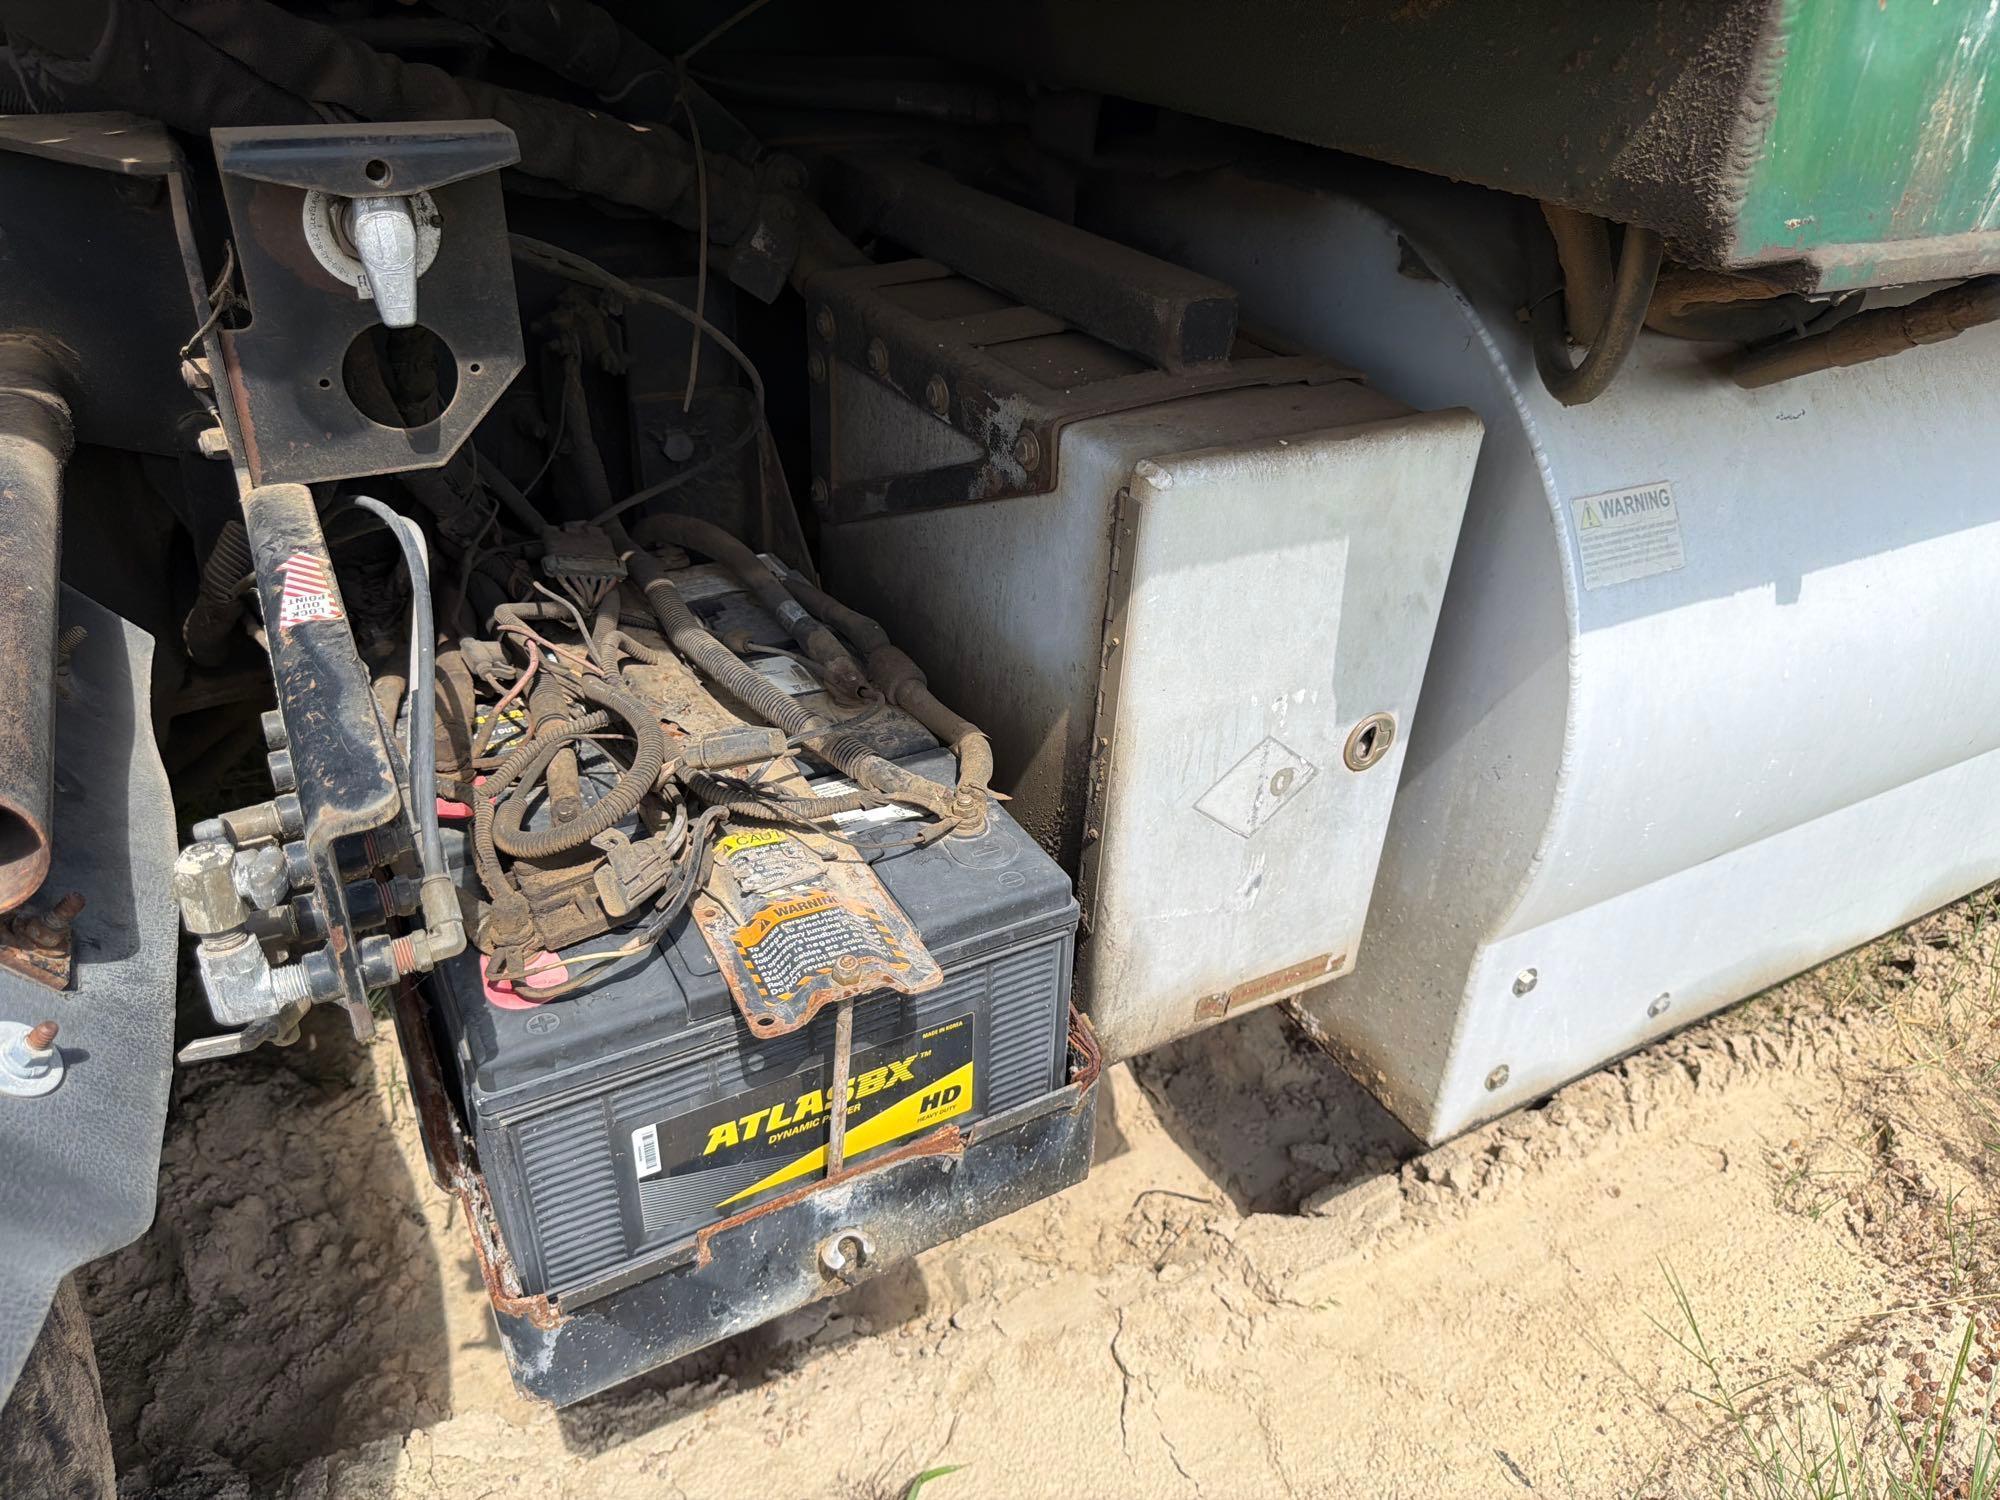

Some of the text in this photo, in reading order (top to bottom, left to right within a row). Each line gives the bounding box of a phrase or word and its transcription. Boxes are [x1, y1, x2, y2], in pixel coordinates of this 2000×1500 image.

[1598, 488, 1671, 520] WARNING
[288, 594, 325, 605] POINT
[291, 608, 325, 618] LOCK
[295, 601, 320, 610] OUT
[751, 933, 784, 959] damage
[786, 926, 796, 934] to
[754, 948, 778, 966] follow
[778, 931, 806, 949] battery
[807, 920, 842, 937] jumping
[761, 927, 780, 947] avoid
[781, 913, 820, 931] personal
[761, 952, 793, 977] system
[793, 946, 804, 954] is
[806, 933, 850, 950] negative
[763, 963, 792, 983] Battery
[793, 947, 823, 963] cables
[824, 943, 840, 952] are
[767, 938, 804, 969] operator's
[805, 925, 850, 944] handbook.
[767, 980, 784, 990] Red
[789, 957, 816, 978] positive
[828, 947, 850, 958] Black
[770, 986, 785, 996] Do
[786, 972, 803, 992] NOT
[922, 1020, 964, 1039] MADE IN KOREA
[917, 1104, 957, 1124] HEAVY DUTY
[919, 1084, 962, 1115] HD
[768, 1101, 861, 1145] DYNAMIC PER
